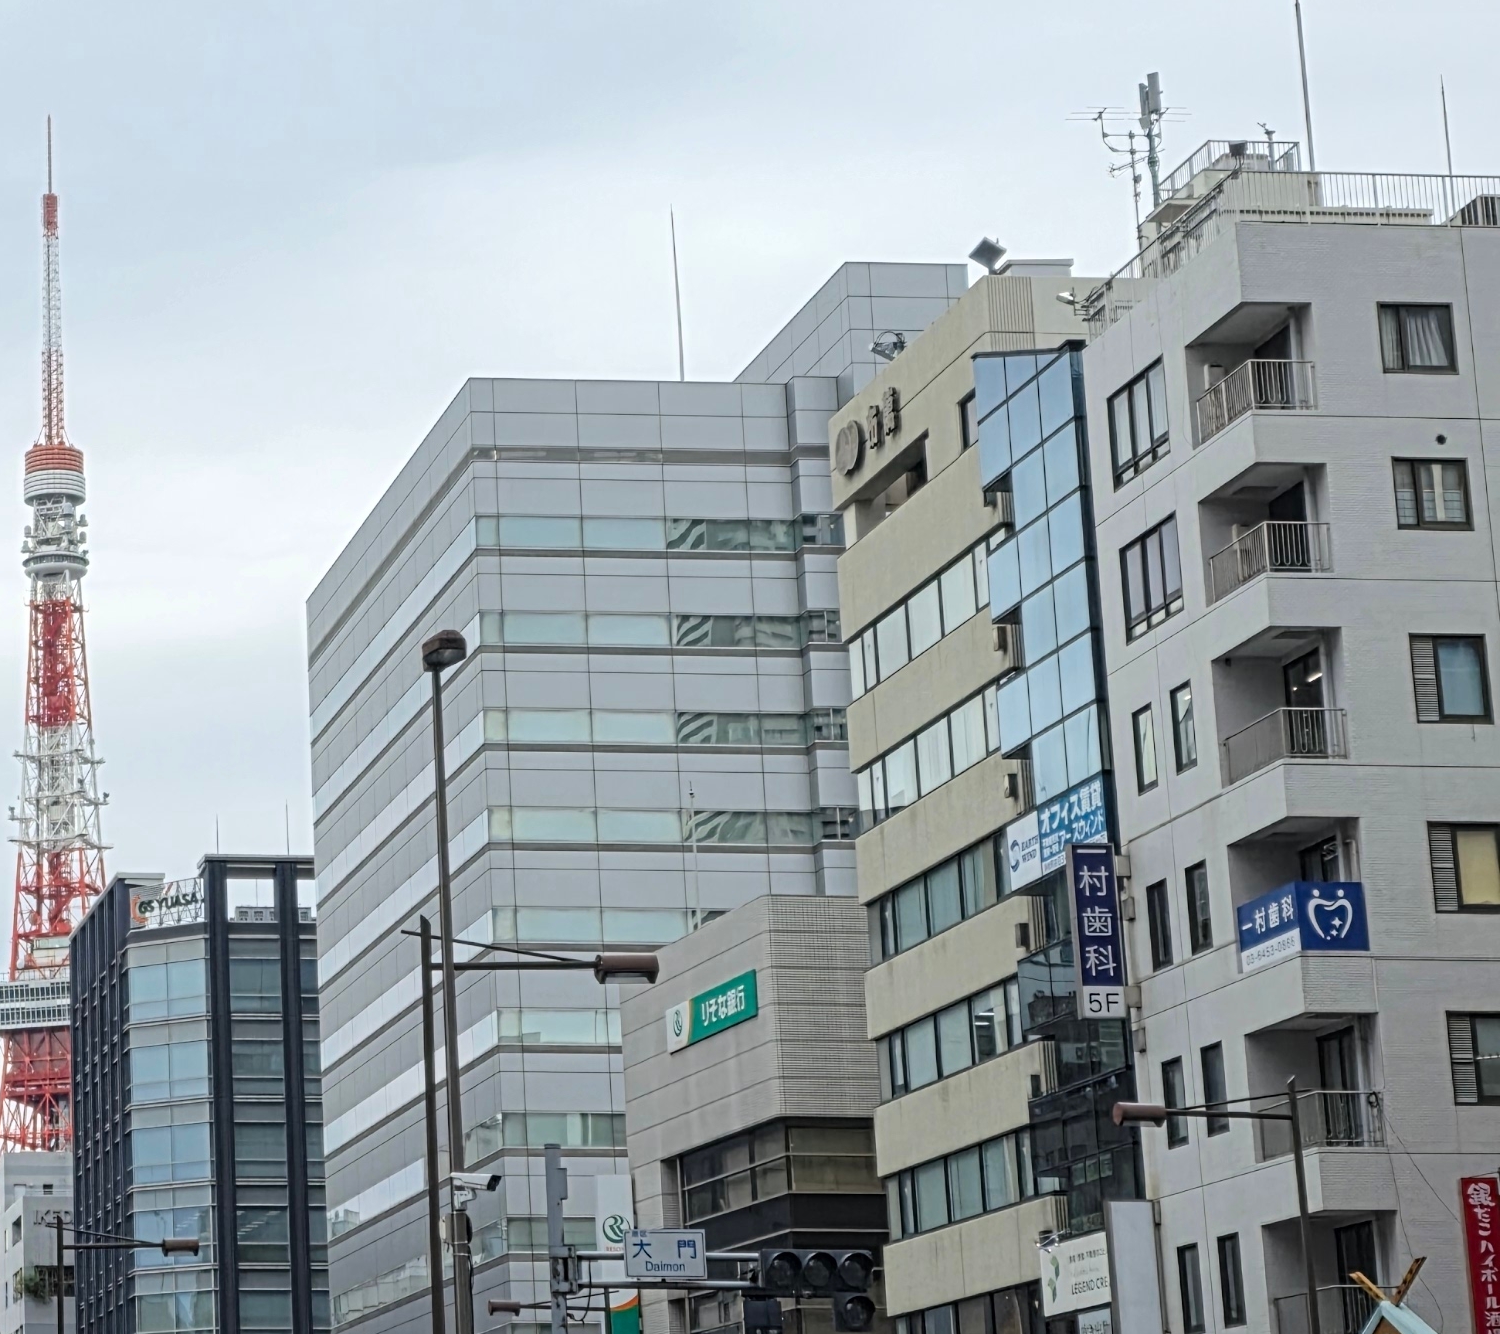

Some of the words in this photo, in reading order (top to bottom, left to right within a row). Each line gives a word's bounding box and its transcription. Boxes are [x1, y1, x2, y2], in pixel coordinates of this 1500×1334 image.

[1076, 849, 1117, 976] 一村歯科
[1242, 895, 1294, 934] 一村歯科
[701, 984, 745, 1027] りそな銀行
[1089, 992, 1120, 1013] 5F
[645, 1260, 686, 1273] Daimon
